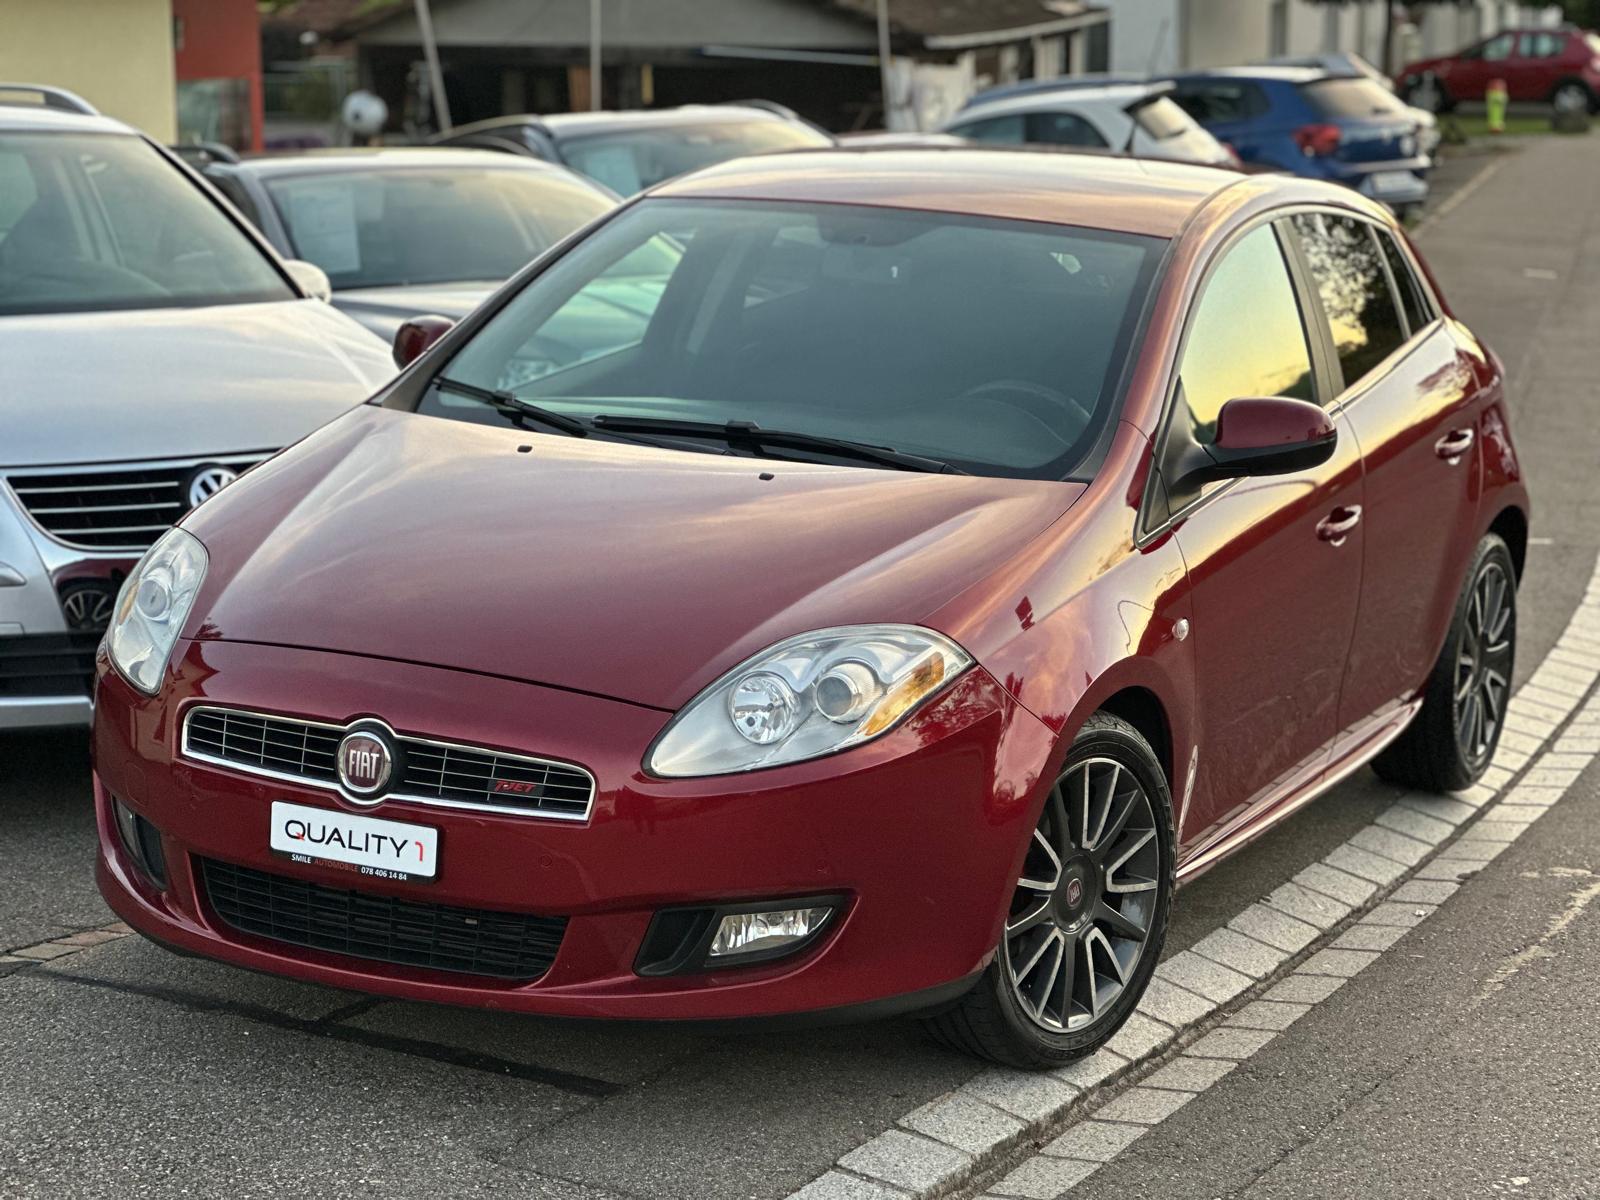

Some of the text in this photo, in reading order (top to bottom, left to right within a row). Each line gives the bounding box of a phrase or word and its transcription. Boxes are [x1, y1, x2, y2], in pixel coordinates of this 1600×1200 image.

[348, 749, 380, 780] FIAT
[284, 819, 424, 862] QUALITY 1
[291, 853, 311, 864] SMILE
[360, 866, 374, 875] 078
[374, 869, 388, 878] 406
[388, 871, 398, 879] 14
[398, 873, 407, 881] 84
